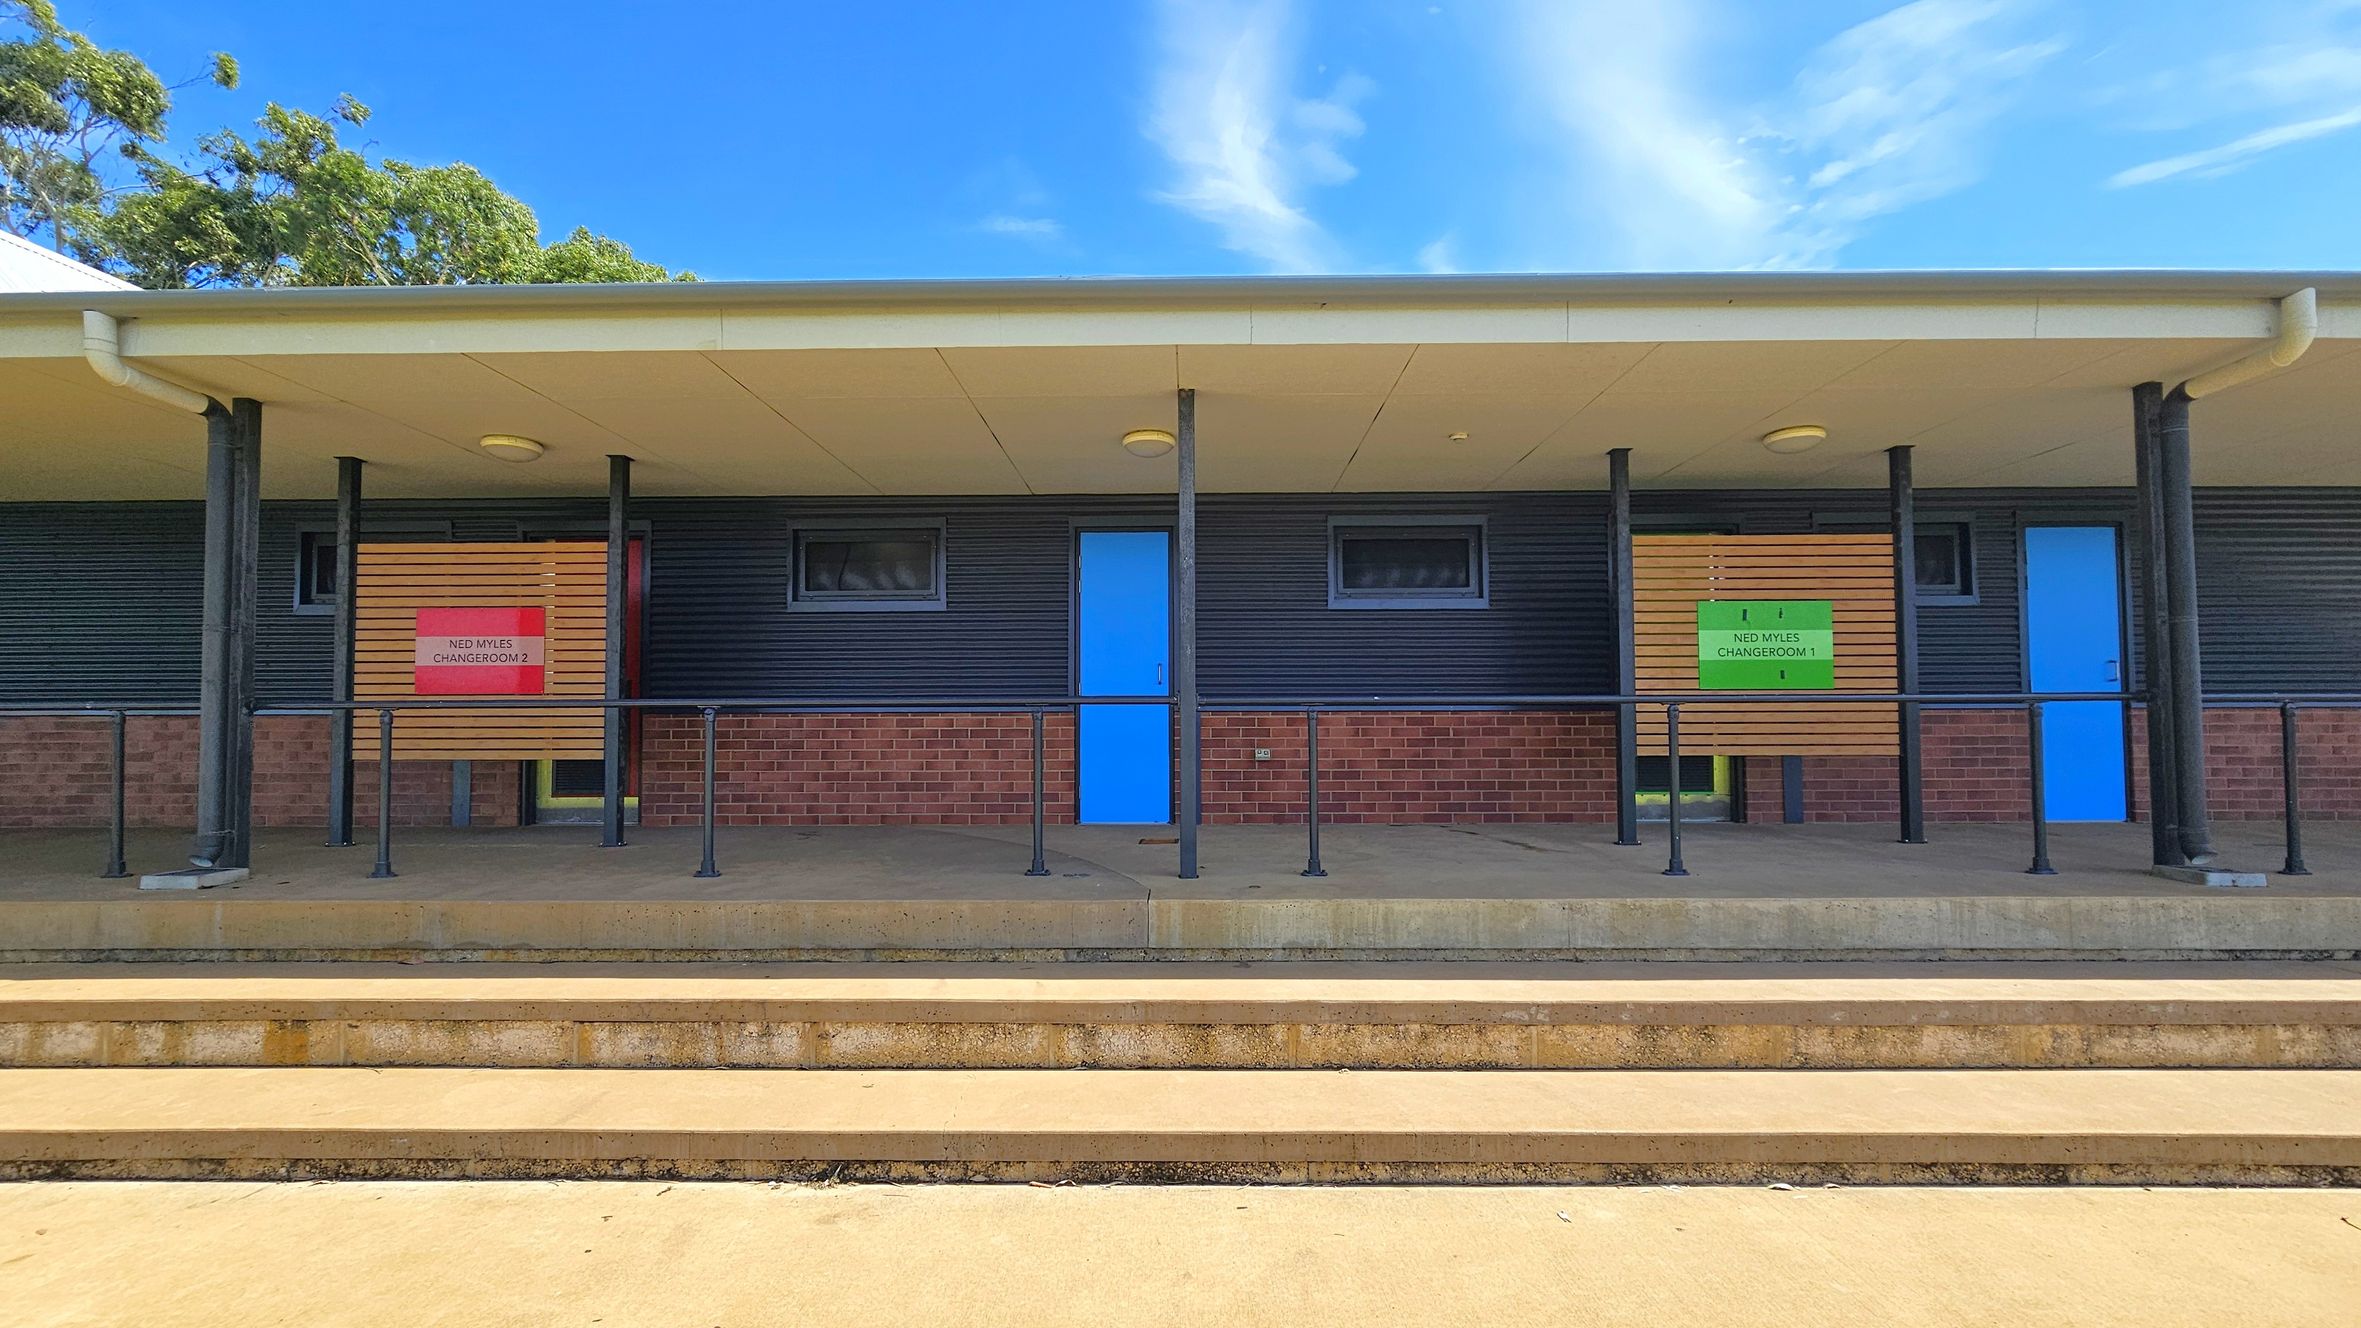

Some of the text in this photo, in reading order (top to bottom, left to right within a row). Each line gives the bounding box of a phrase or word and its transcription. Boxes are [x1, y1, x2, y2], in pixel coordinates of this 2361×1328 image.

[1734, 633, 1800, 643] NED MYLES
[449, 640, 513, 649] NED MYLES
[1717, 647, 1815, 657] CHANGEROOM 1
[433, 653, 528, 663] CHANGEROOM 2
